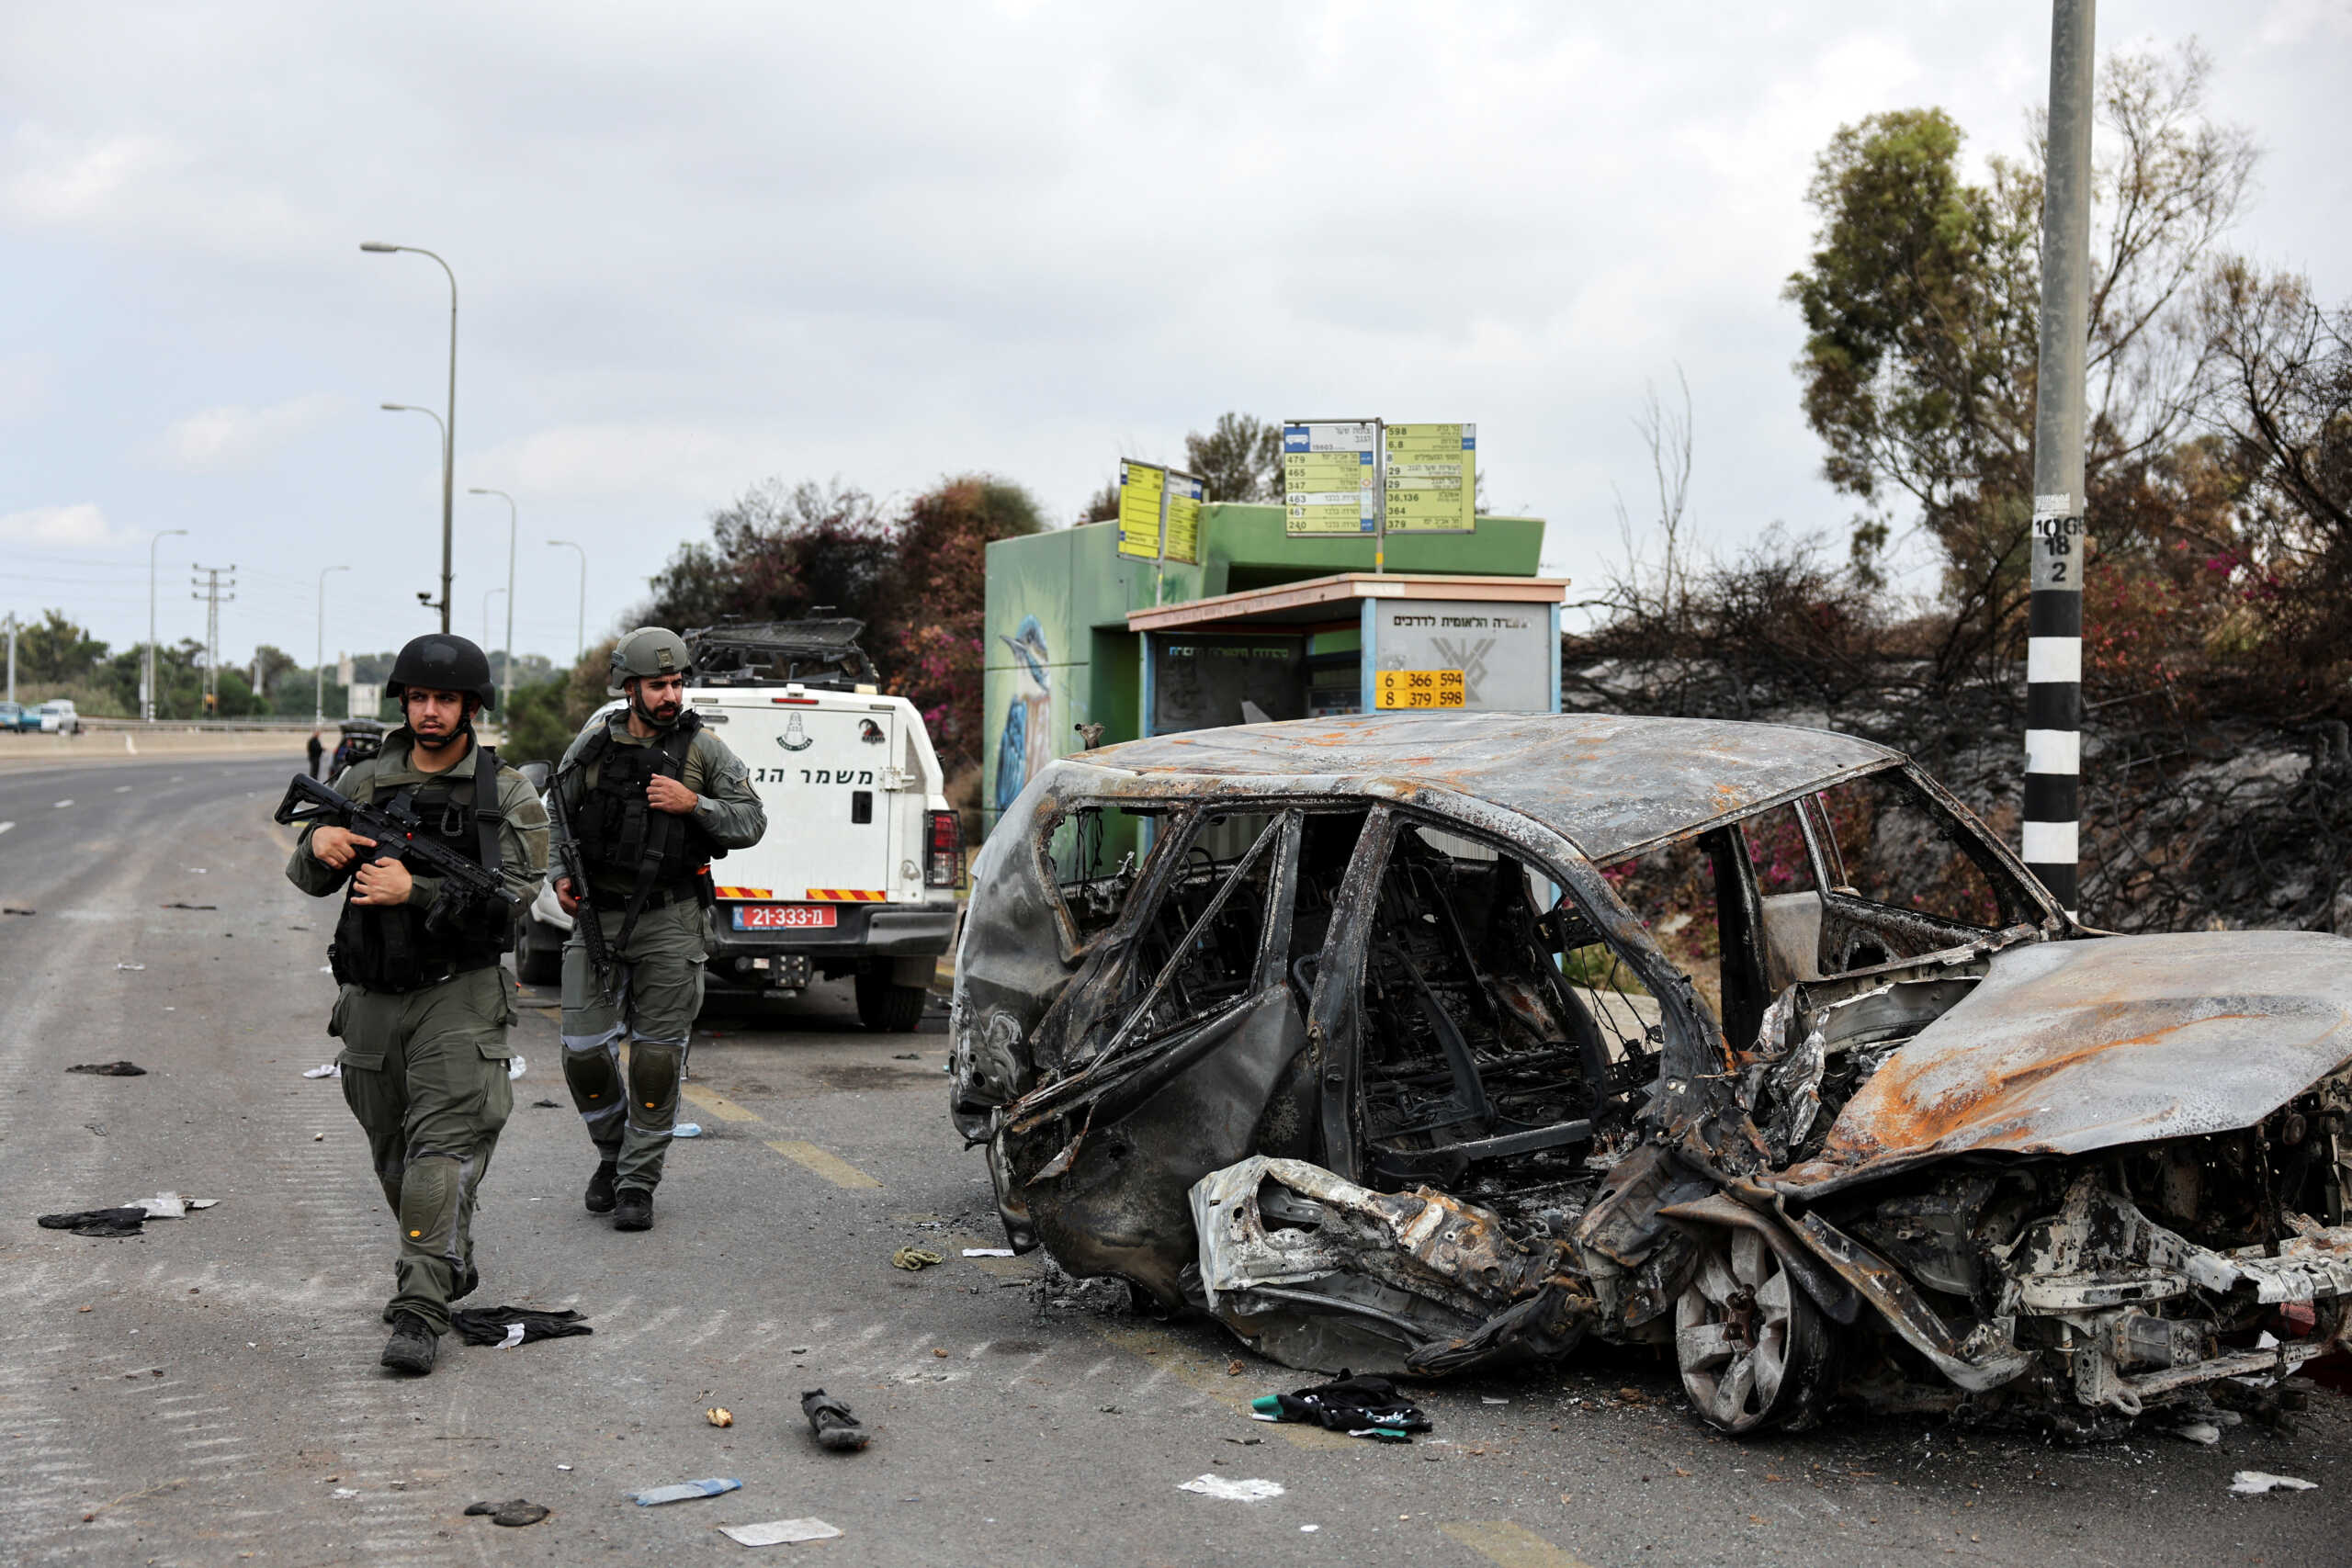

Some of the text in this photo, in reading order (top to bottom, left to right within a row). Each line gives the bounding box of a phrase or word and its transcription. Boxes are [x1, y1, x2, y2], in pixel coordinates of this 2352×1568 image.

[1388, 427, 1407, 435] 598
[1288, 468, 1306, 477] 465
[1288, 481, 1306, 490] 347
[2044, 536, 2071, 556] 18
[2052, 562, 2066, 582] 2
[1394, 615, 1435, 626] לדרכים
[1441, 616, 1487, 628] הלאומית
[1385, 673, 1463, 687] 6 366 594
[1385, 692, 1463, 705] 8 379 598
[799, 769, 874, 784] משמר
